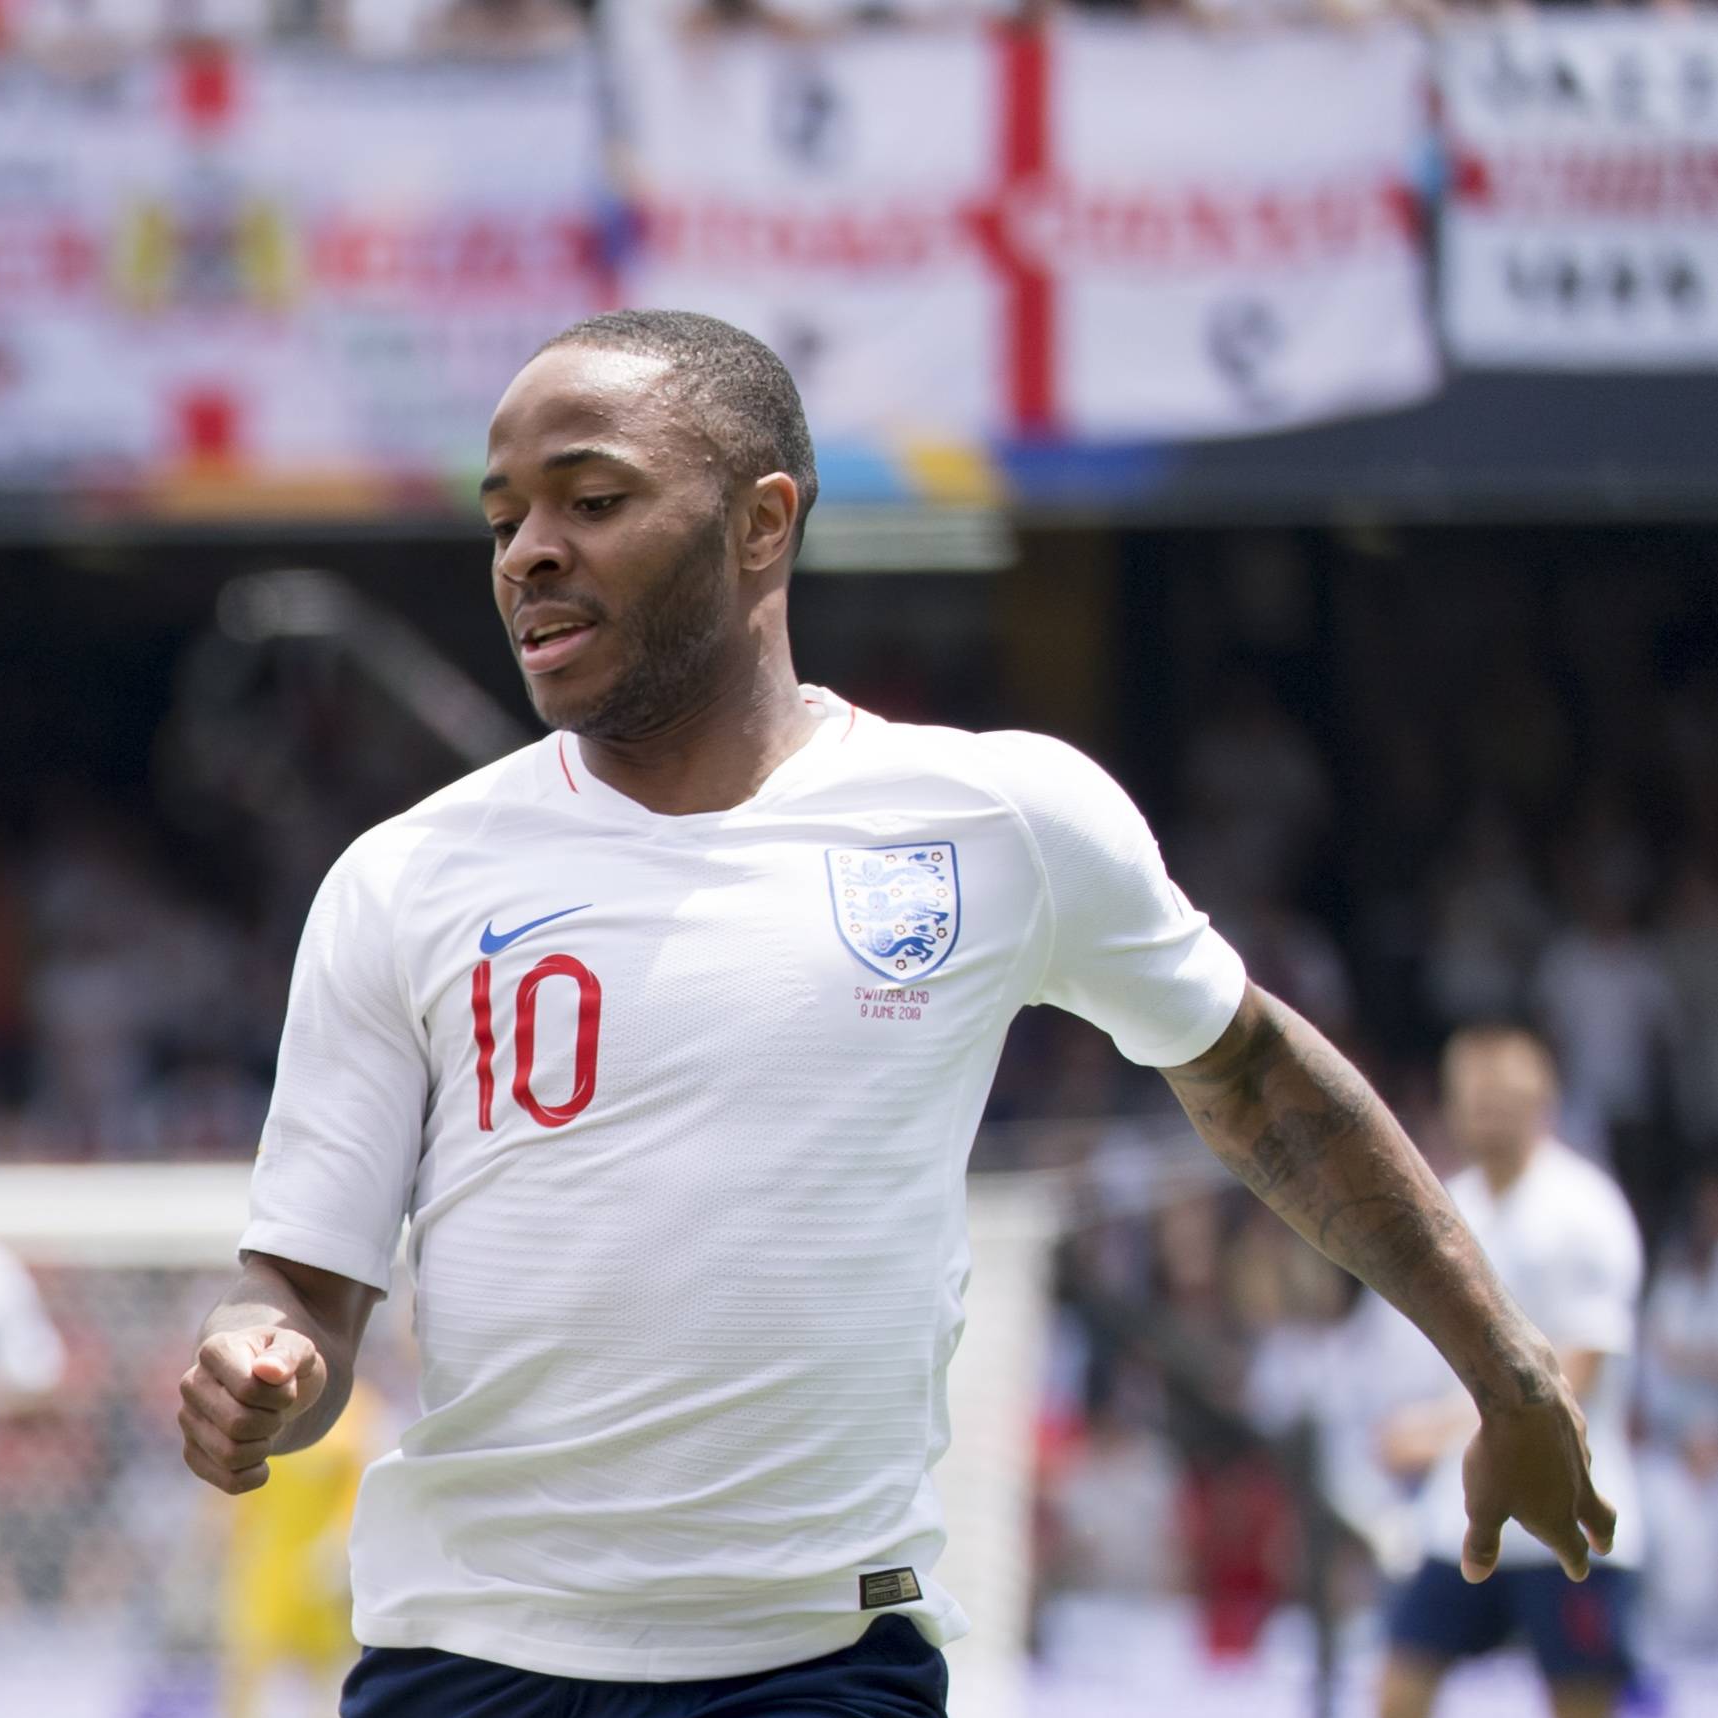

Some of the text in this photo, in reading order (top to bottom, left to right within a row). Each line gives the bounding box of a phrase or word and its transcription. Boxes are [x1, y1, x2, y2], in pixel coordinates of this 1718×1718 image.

[853, 986, 930, 1005] SWITZERLAND
[860, 1003, 922, 1021] 9 JUNE 2019
[471, 953, 603, 1131] 10
